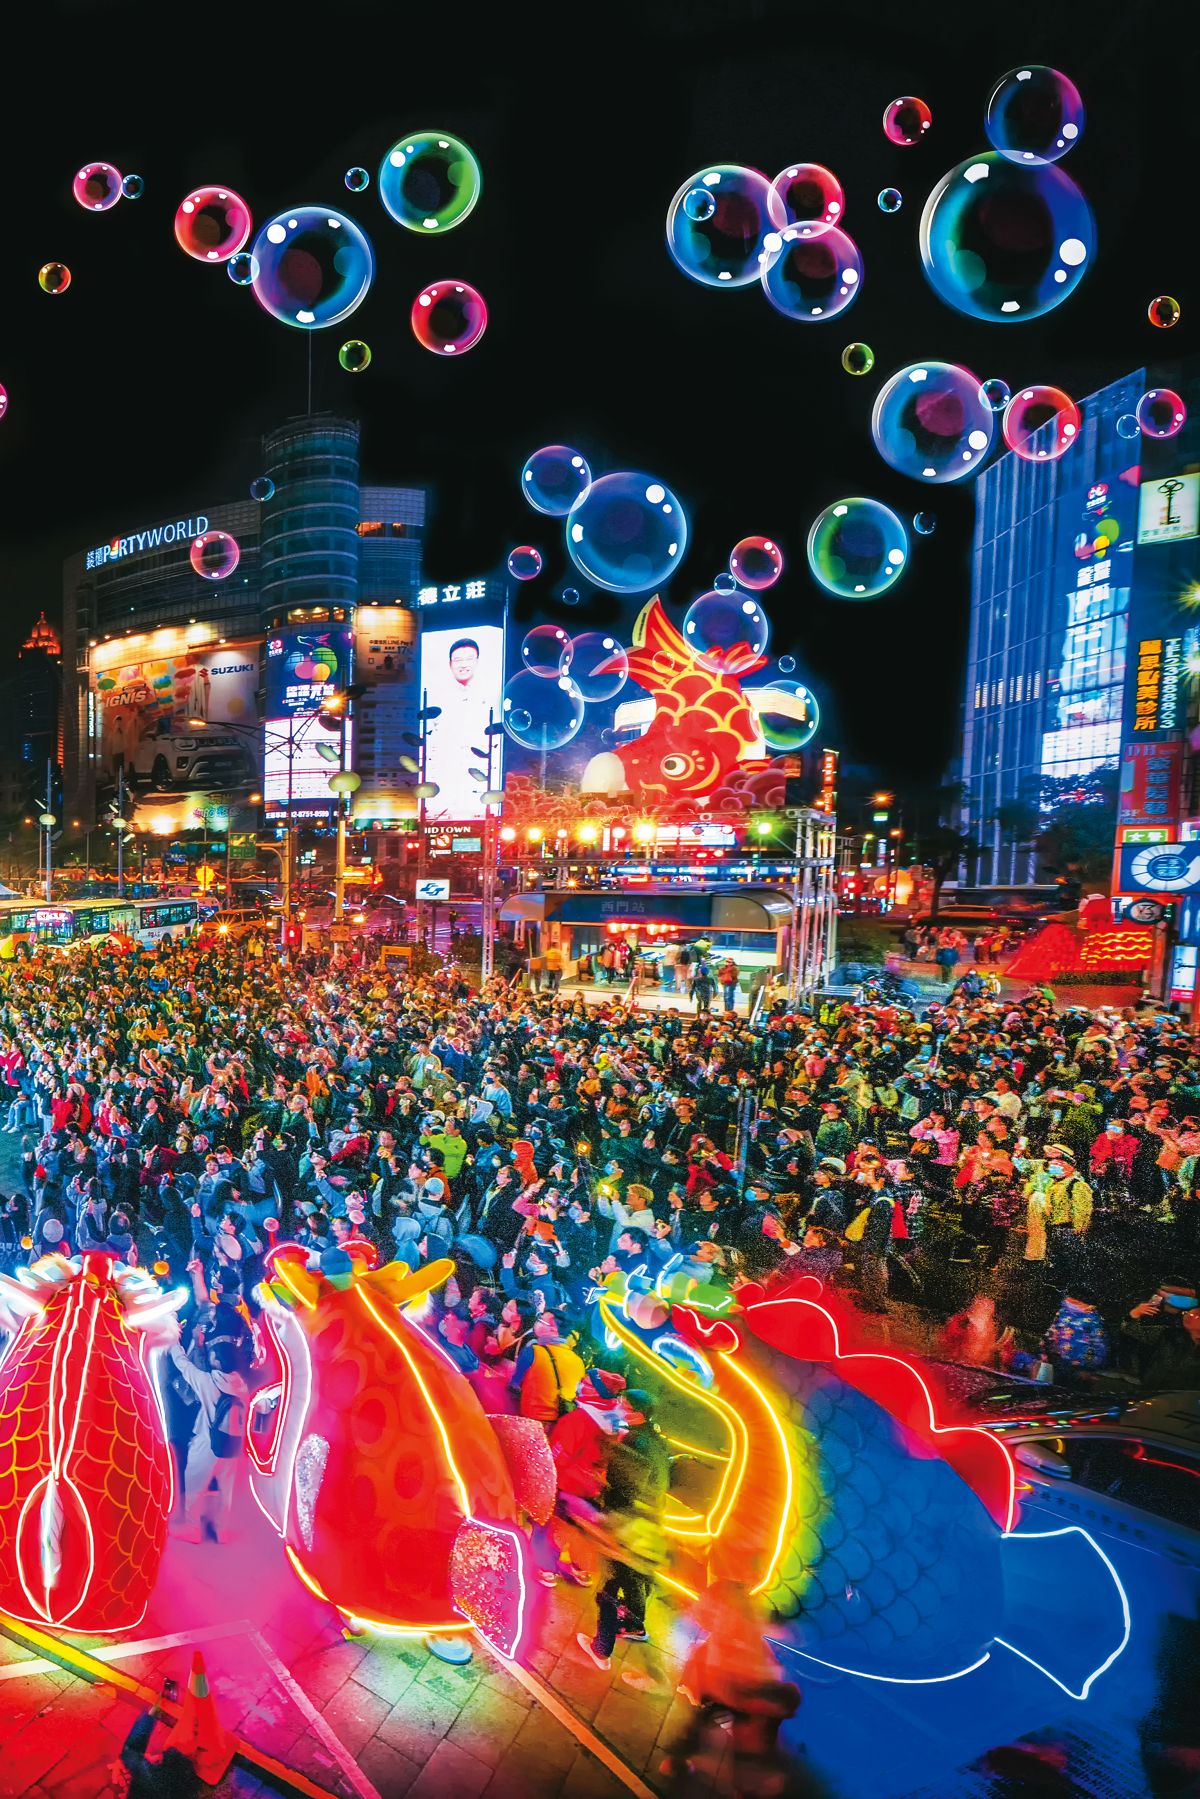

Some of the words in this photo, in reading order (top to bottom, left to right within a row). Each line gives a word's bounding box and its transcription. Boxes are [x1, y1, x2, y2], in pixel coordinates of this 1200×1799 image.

[417, 580, 487, 606] 德立莊
[210, 663, 254, 676] SUZUKI
[105, 690, 147, 708] IGNIS
